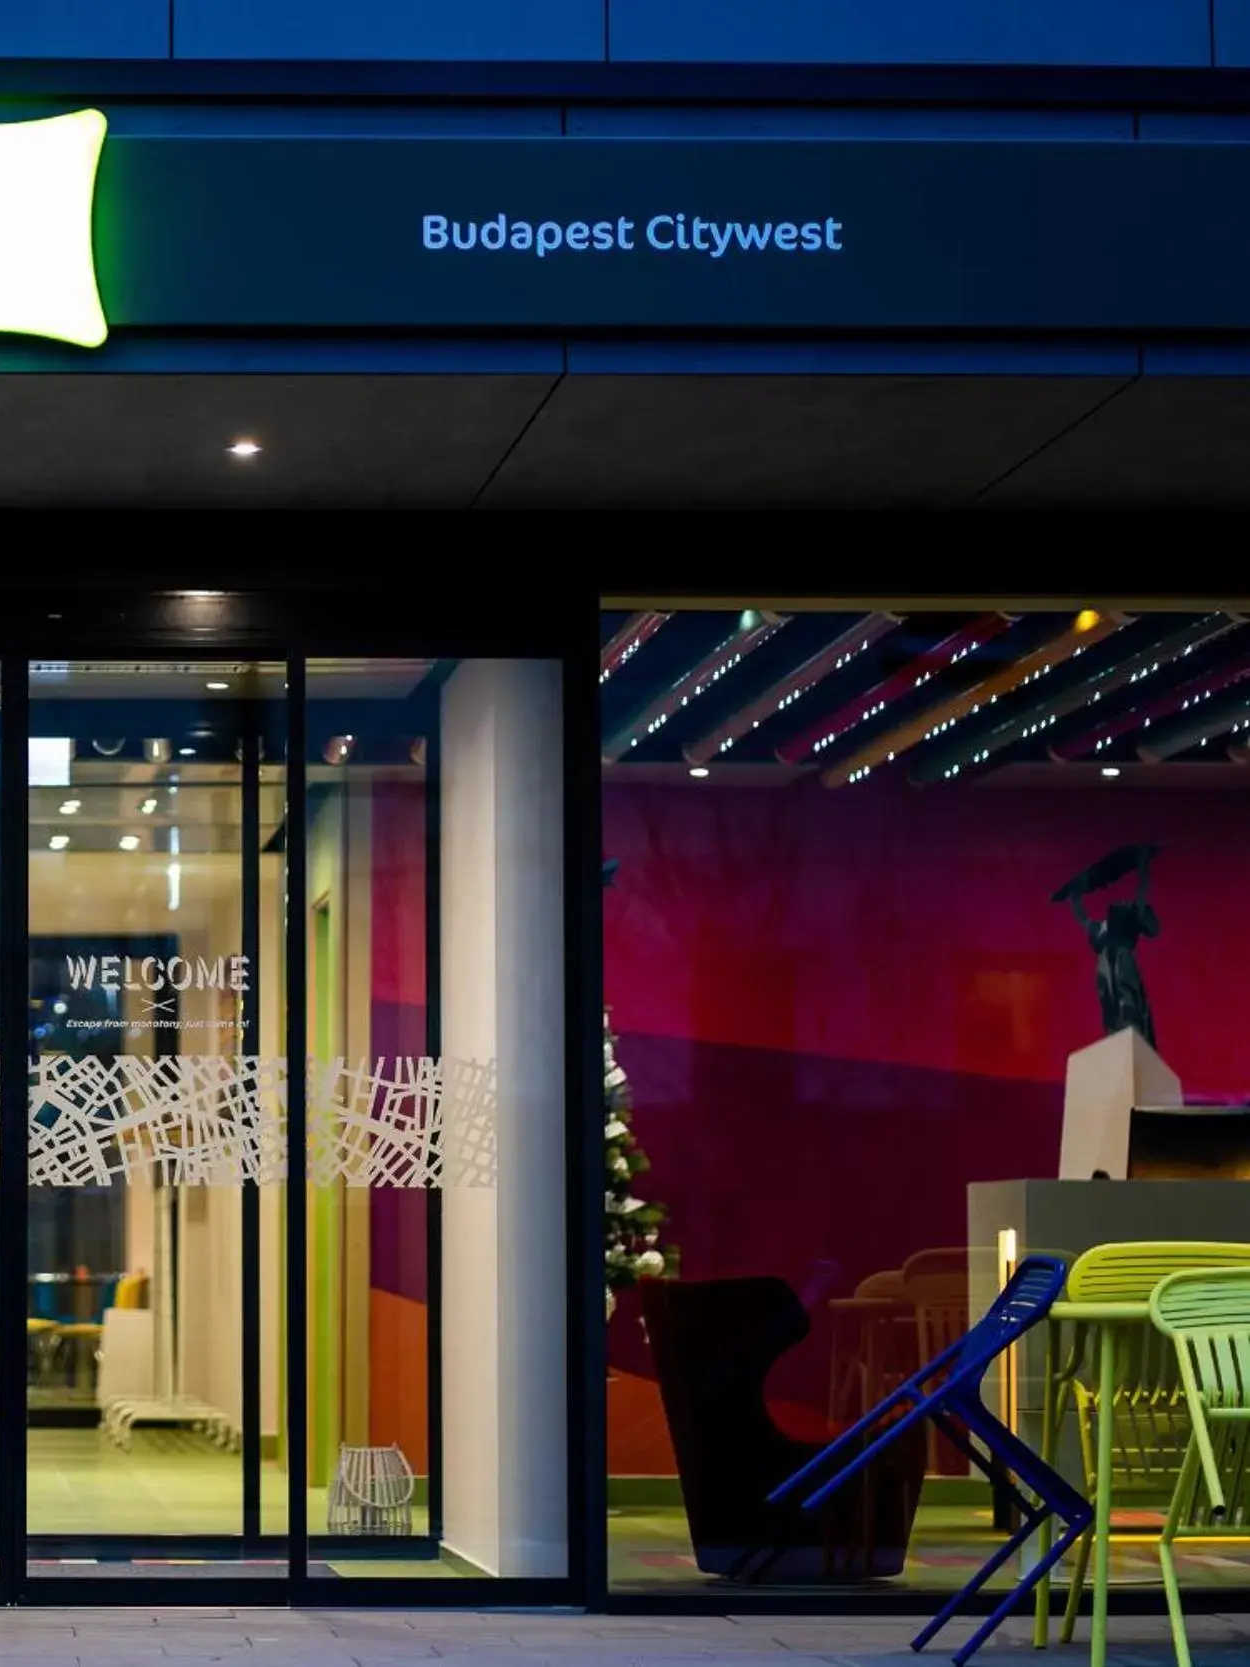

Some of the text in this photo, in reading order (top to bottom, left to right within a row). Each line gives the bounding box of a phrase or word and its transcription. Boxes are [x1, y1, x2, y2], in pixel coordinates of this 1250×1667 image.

[422, 213, 843, 258] Budapest Citywest
[65, 954, 250, 991] WELCOME
[66, 1019, 103, 1031] Escape
[104, 1019, 129, 1029] from
